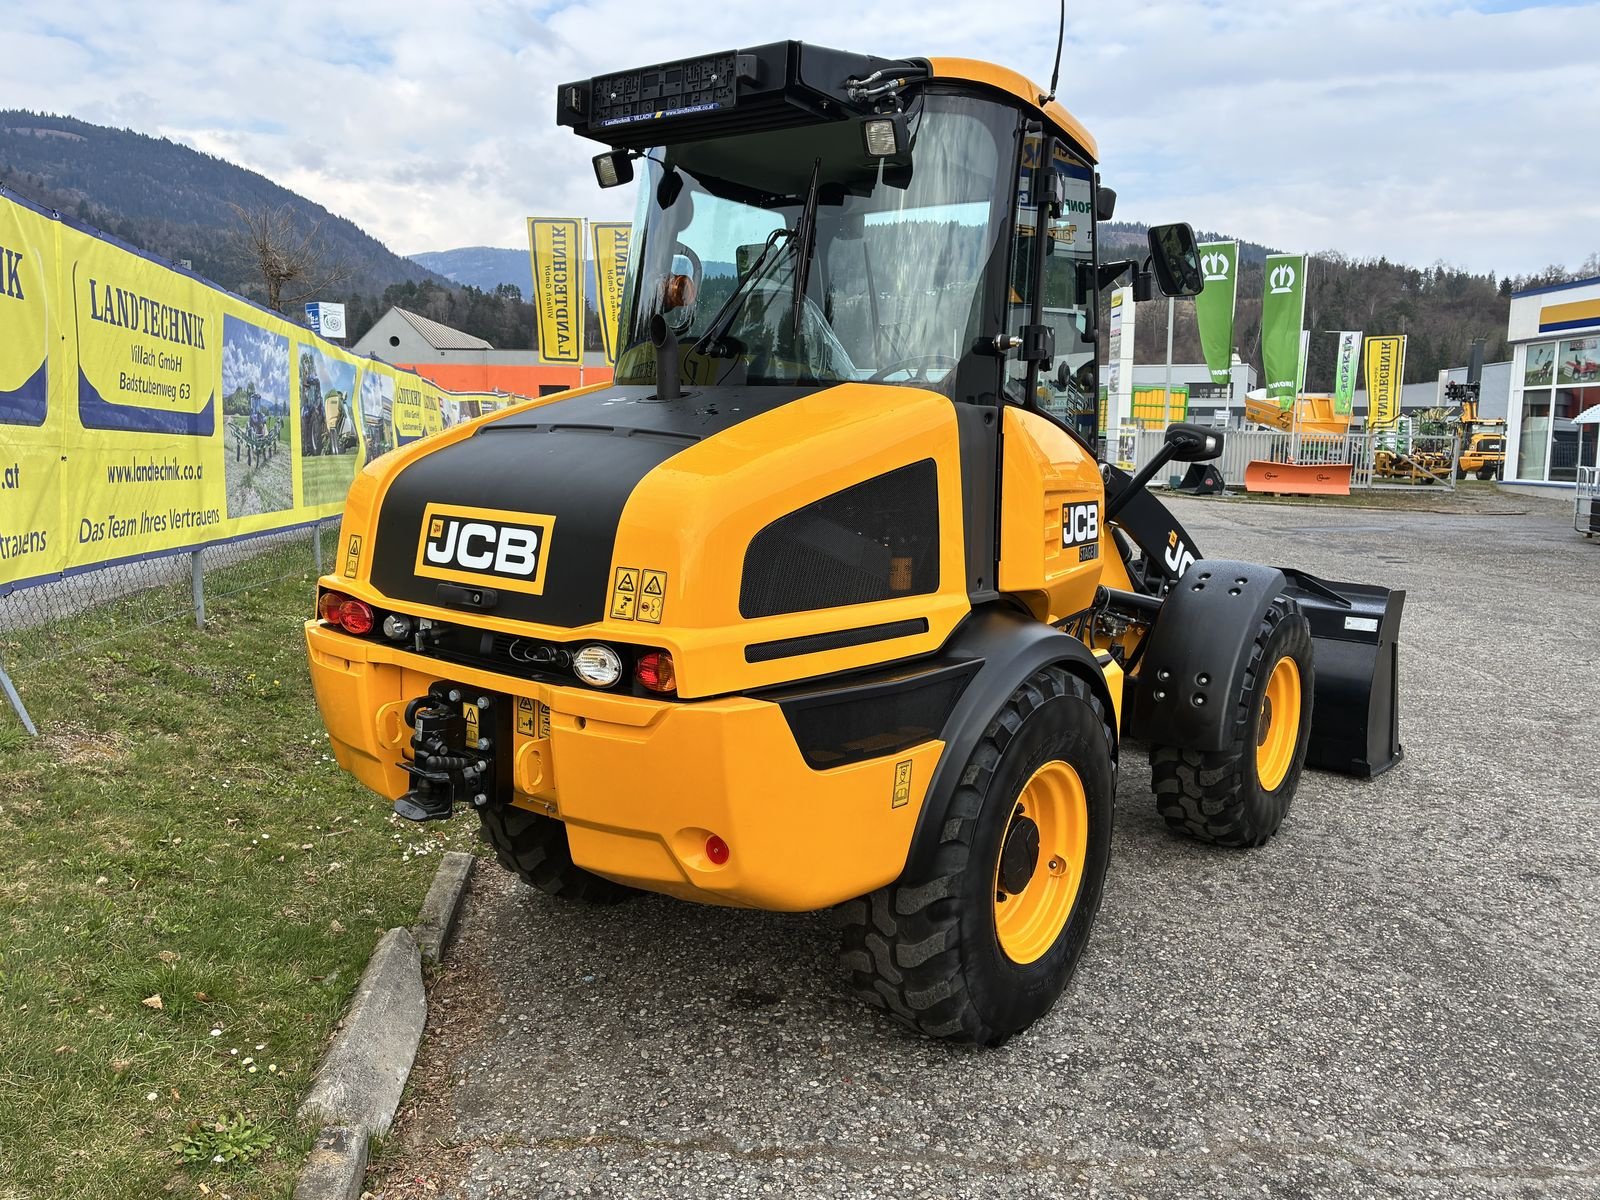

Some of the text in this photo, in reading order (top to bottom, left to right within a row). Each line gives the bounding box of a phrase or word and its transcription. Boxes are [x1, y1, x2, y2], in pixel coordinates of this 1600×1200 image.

[89, 278, 205, 350] LANDTECHNIK
[131, 344, 183, 372] Villach GmbH
[119, 372, 191, 402] Badstubenweg 63
[107, 456, 203, 483] www.landtechnik.co.a
[79, 508, 219, 544] Das Team Ihres Vertrauens
[1063, 504, 1098, 544] JCB
[427, 521, 538, 575] JCB
